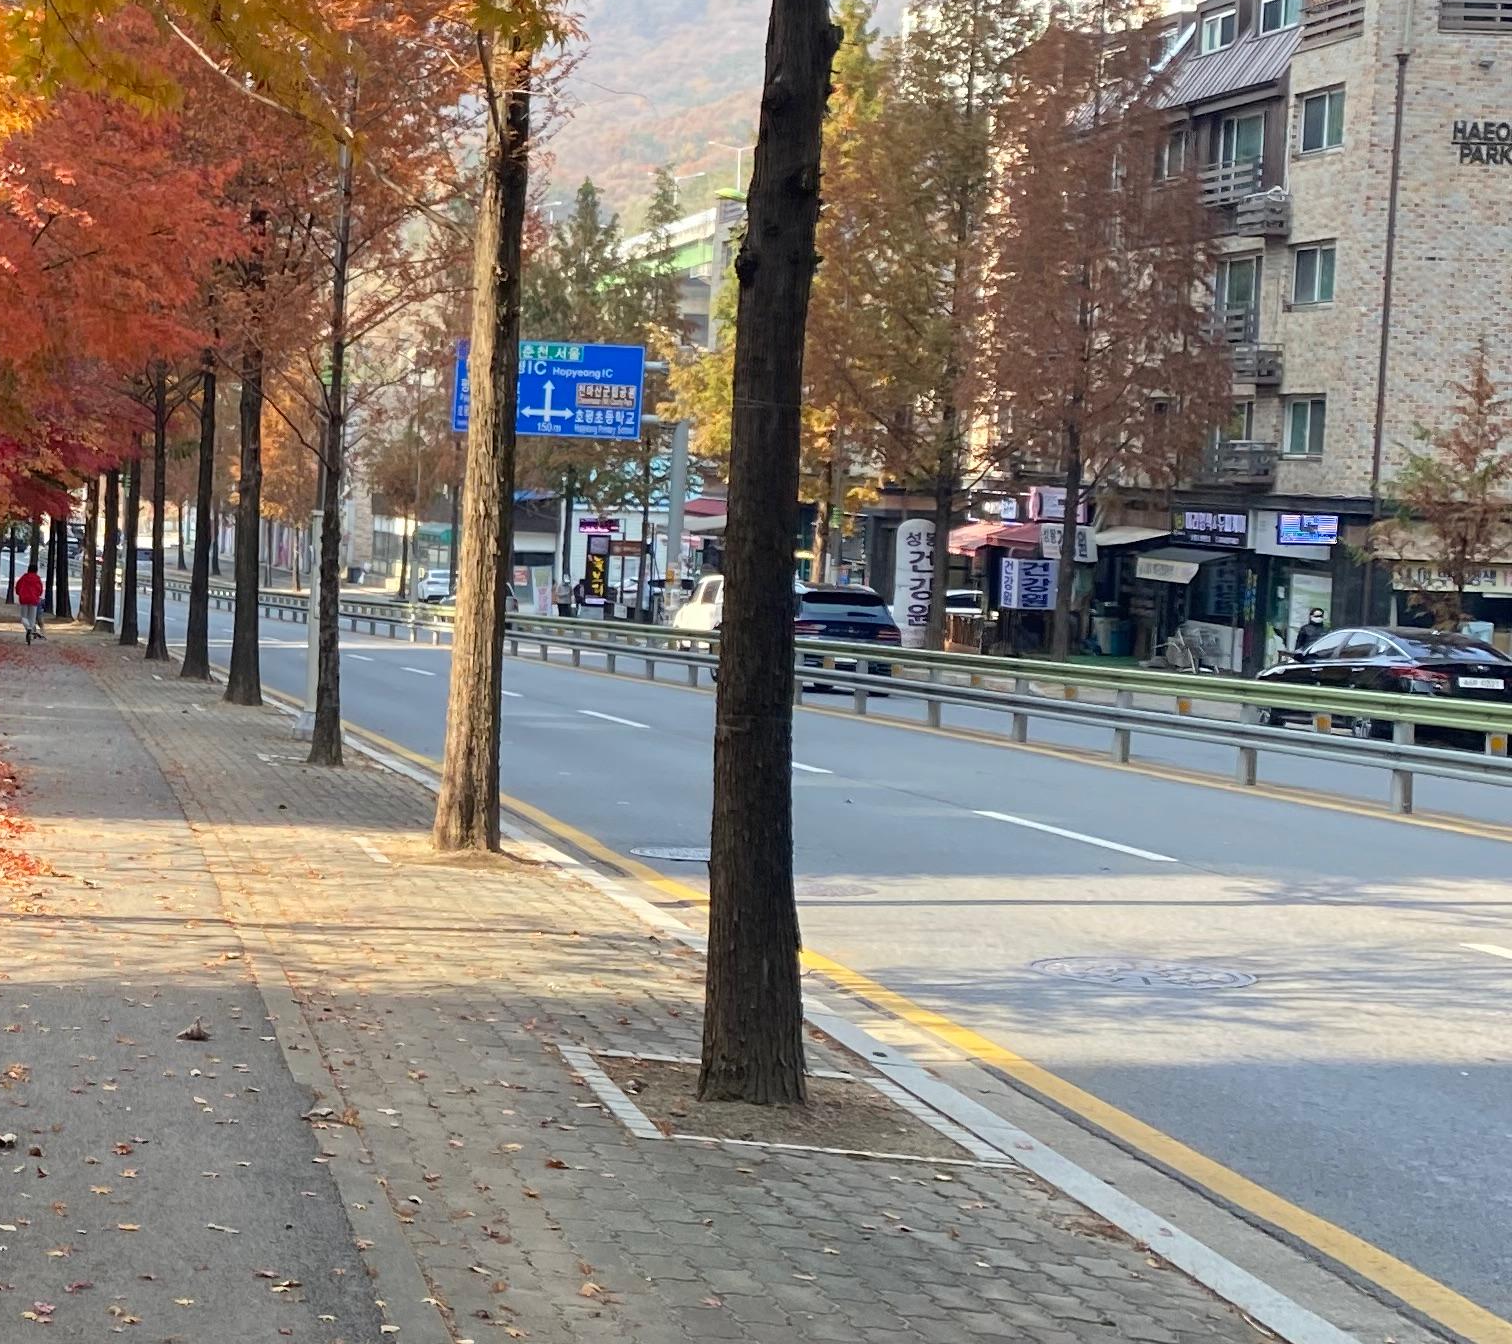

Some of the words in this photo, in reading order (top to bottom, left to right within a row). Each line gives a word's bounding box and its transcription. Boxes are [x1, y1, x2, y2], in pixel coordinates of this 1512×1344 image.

[1453, 120, 1512, 141] HAEO
[1460, 144, 1512, 164] PARK
[555, 347, 580, 361] 서울
[574, 409, 635, 425] 호평초등학교
[907, 550, 934, 627] 건강원
[1004, 560, 1014, 607] 건강원
[1021, 561, 1050, 608] 건강원
